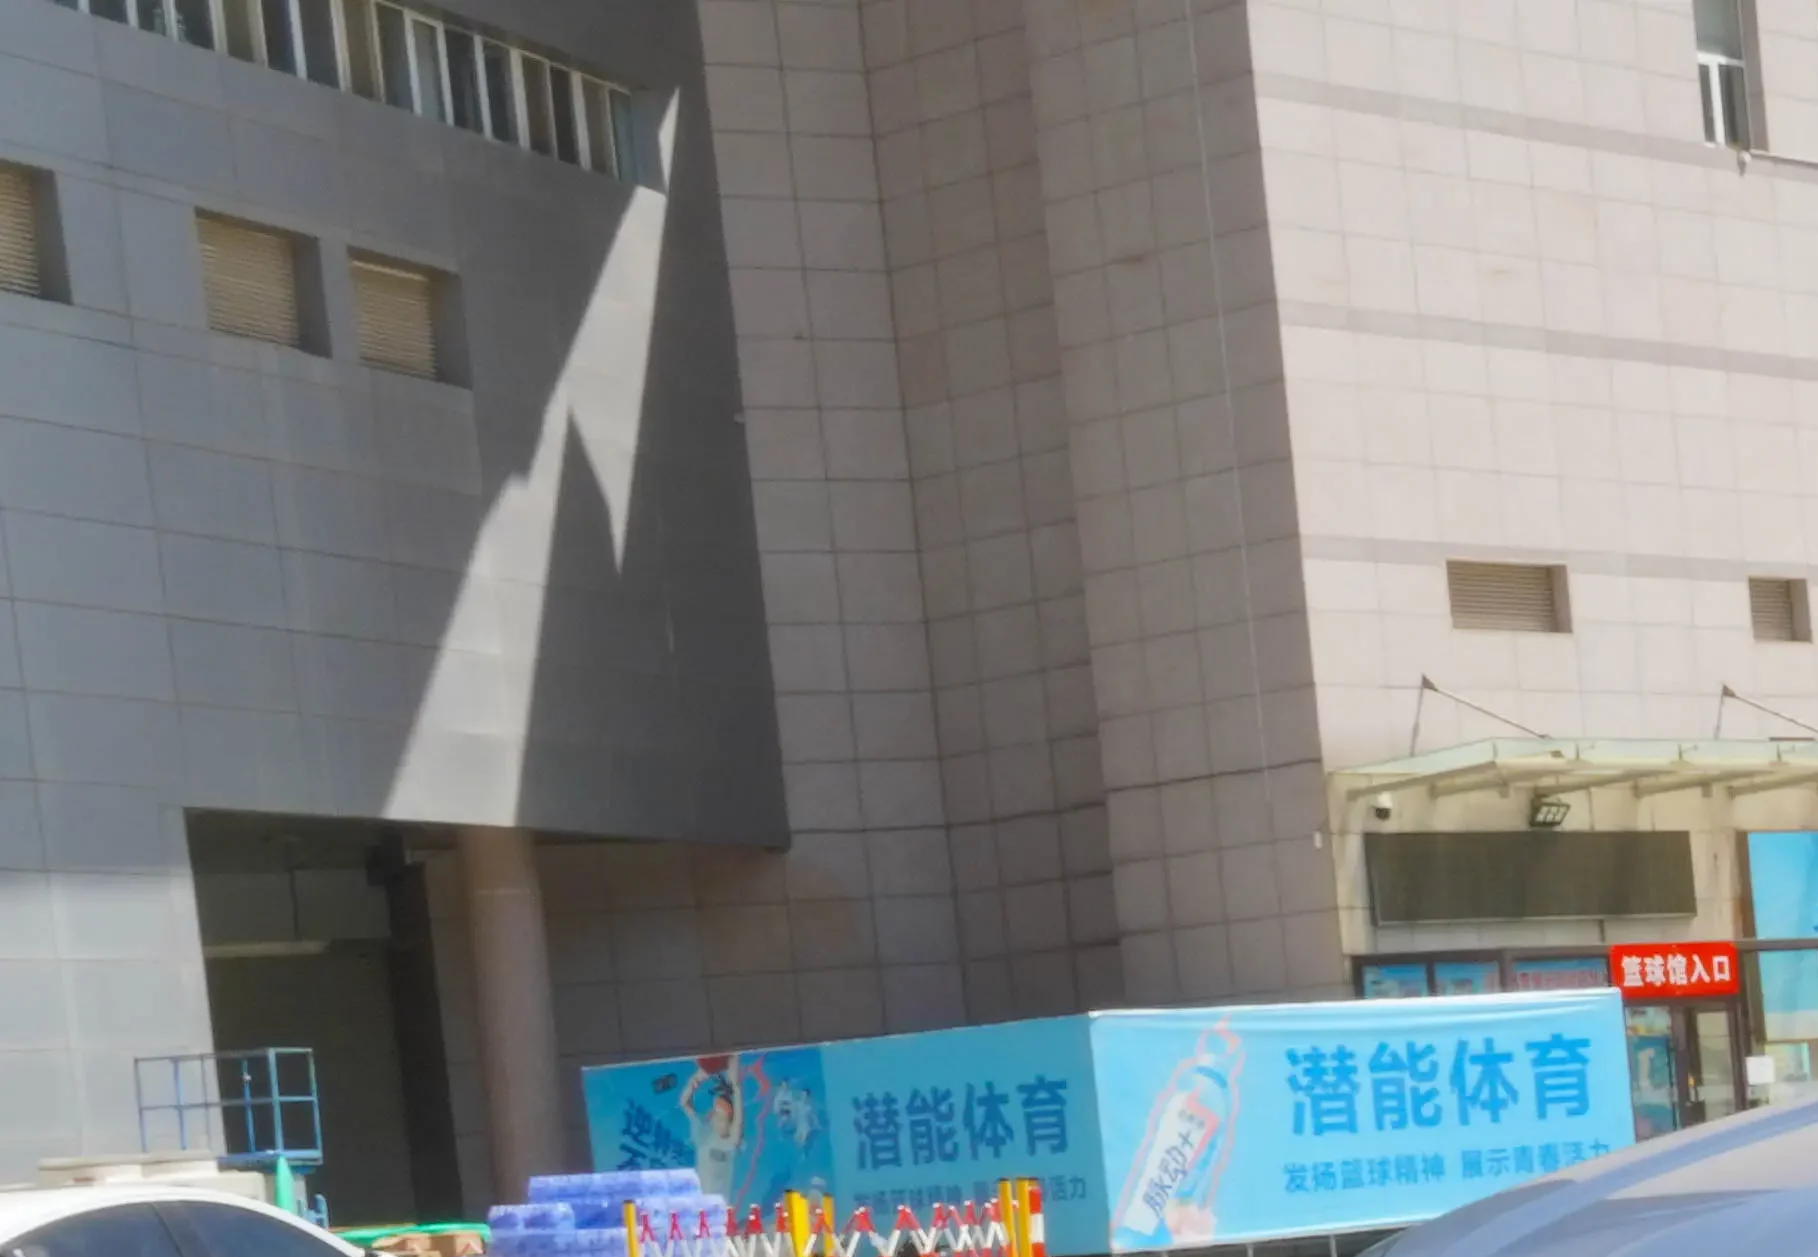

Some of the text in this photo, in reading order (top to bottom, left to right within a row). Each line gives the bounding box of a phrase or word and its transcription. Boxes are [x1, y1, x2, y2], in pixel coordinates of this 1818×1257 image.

[1621, 953, 1731, 988] 篮球馆入口
[1284, 1033, 1592, 1136] 潜能体育
[851, 1074, 1069, 1172] 潜能体育
[1283, 1152, 1446, 1194] 发扬篮球精神
